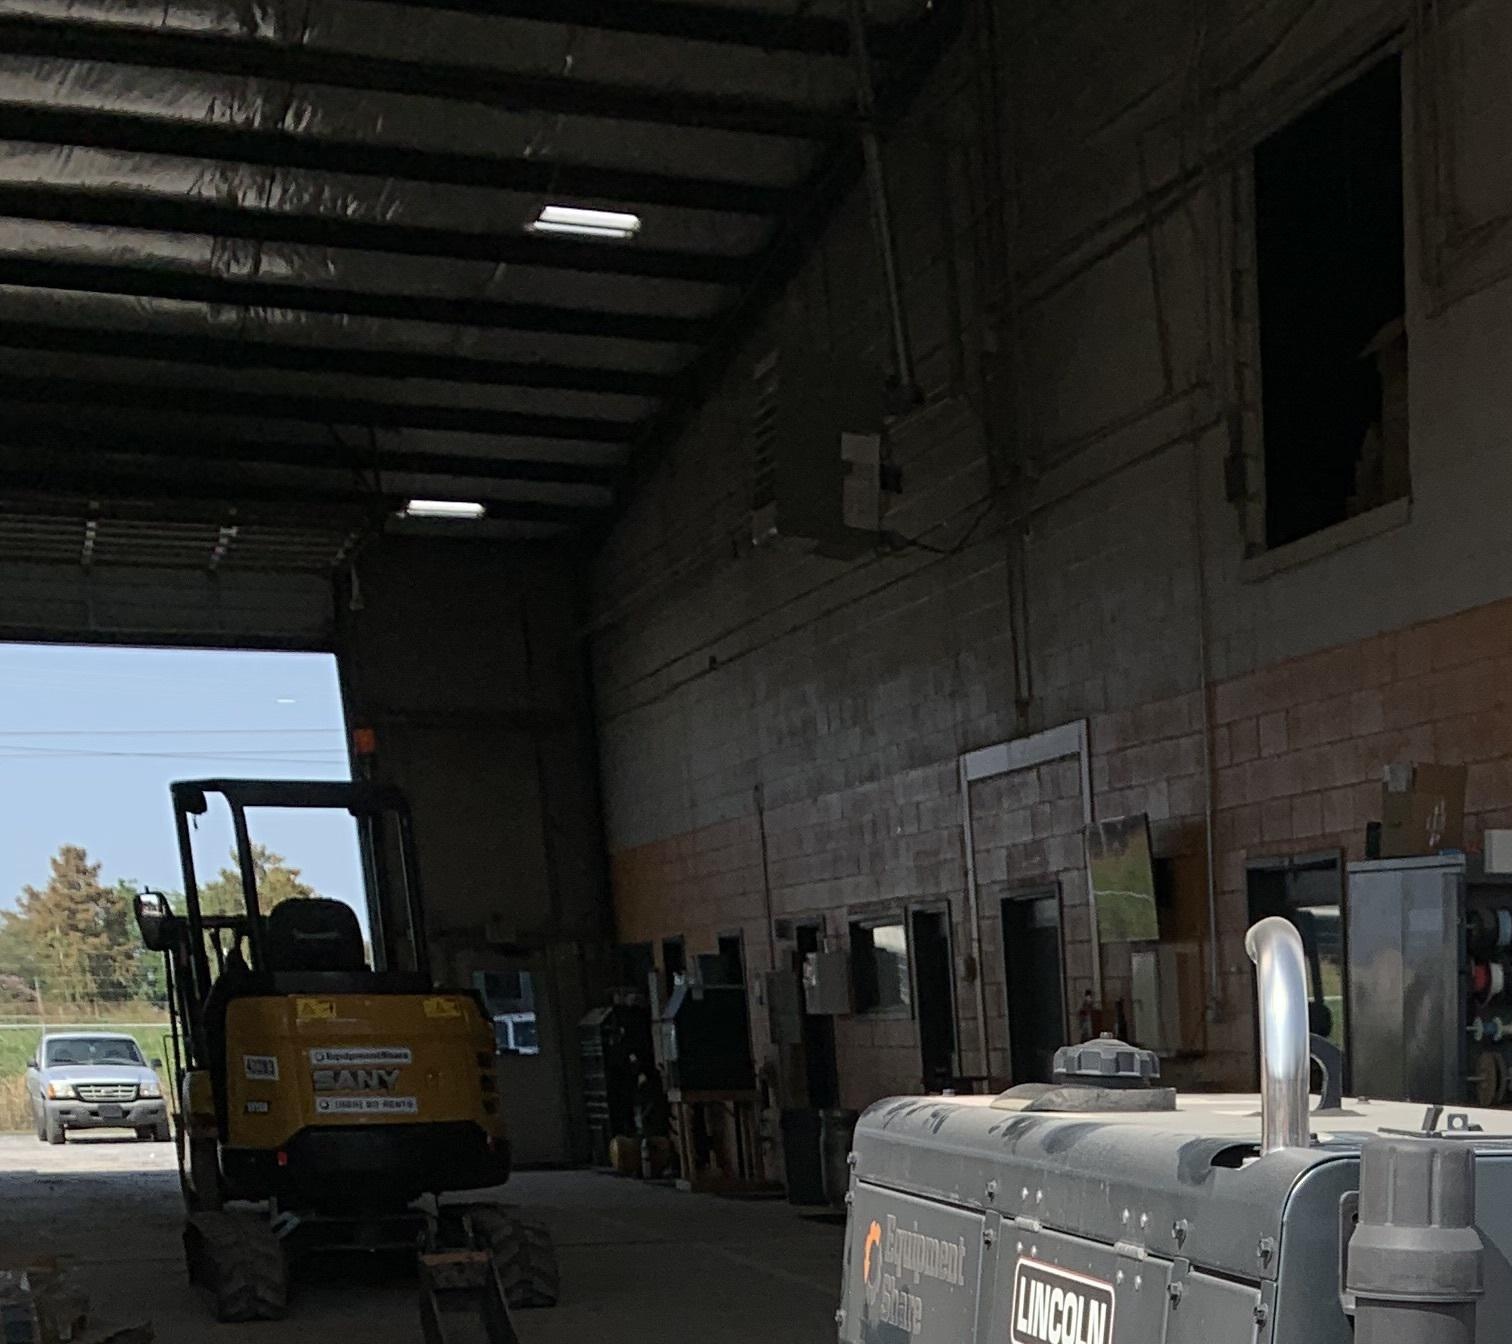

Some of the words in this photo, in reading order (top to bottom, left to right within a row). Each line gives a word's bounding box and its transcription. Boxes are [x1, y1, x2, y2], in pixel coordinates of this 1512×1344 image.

[314, 1069, 399, 1091] SANY
[883, 1214, 966, 1286] Equipment
[880, 1272, 922, 1335] Share
